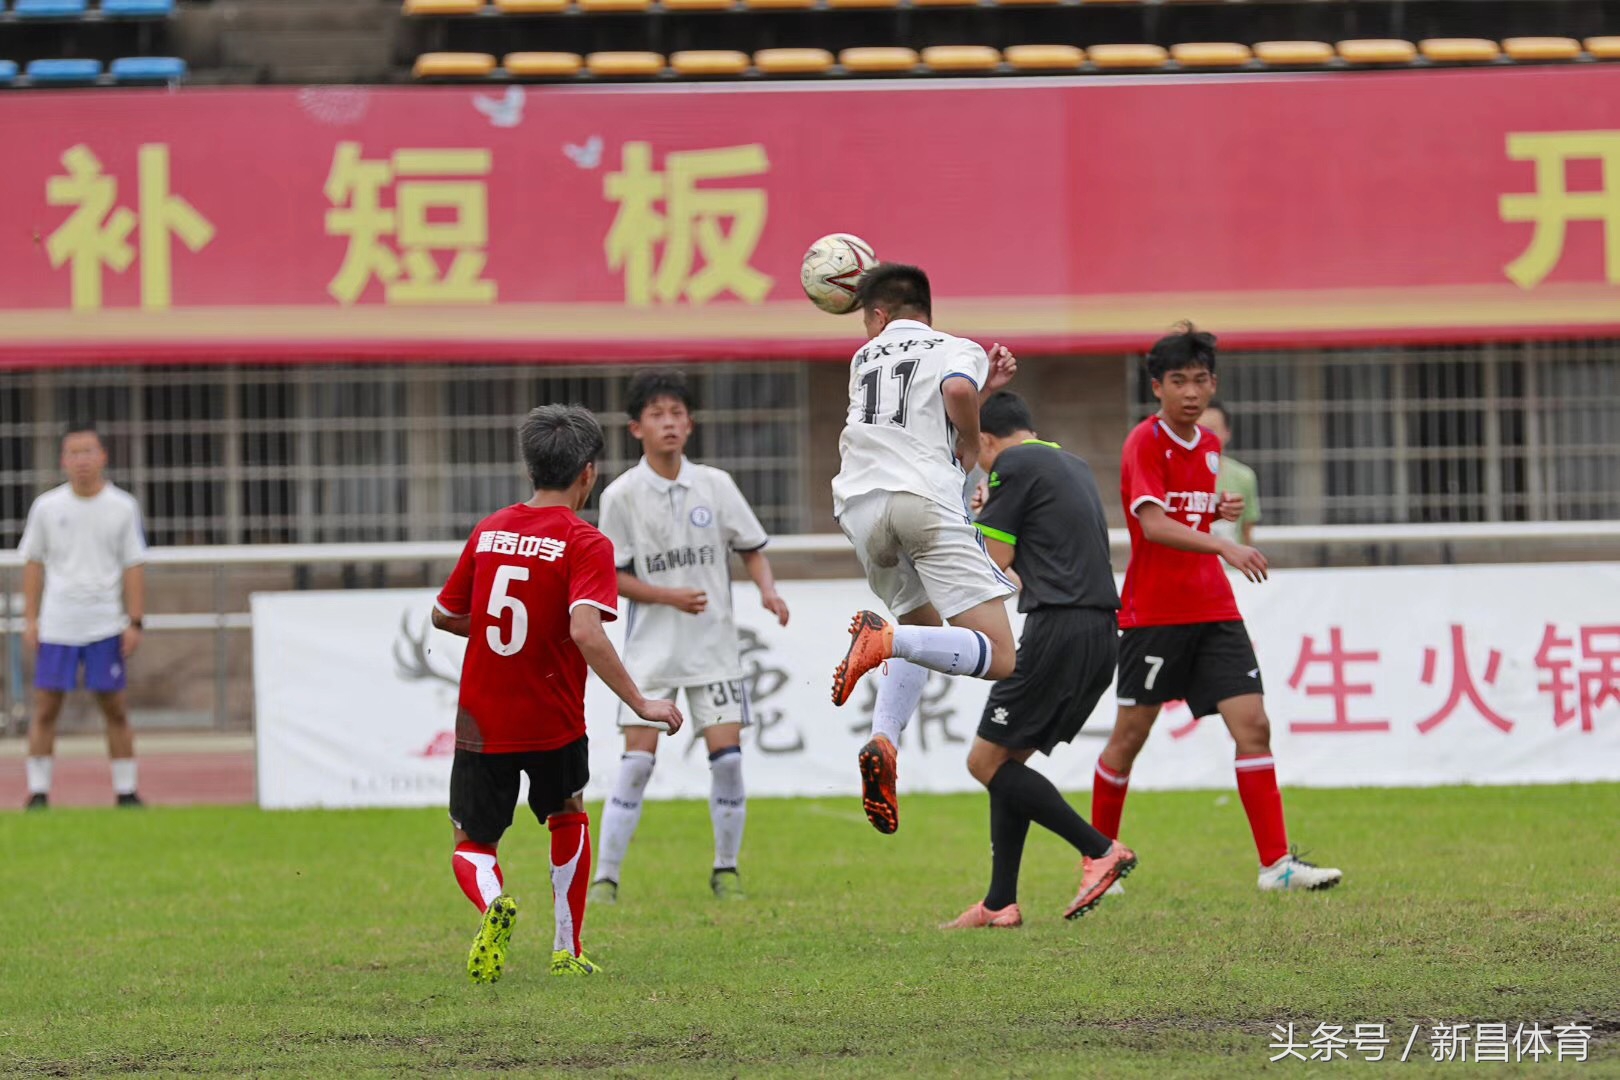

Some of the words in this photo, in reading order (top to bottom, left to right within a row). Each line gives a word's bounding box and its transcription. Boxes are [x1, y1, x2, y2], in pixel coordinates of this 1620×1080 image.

[45, 140, 775, 312] 补短板
[1498, 129, 1620, 290] 开
[858, 358, 921, 428] 11
[485, 564, 530, 657] 5
[1144, 656, 1164, 690] 7
[1163, 622, 1620, 739] 生火锅
